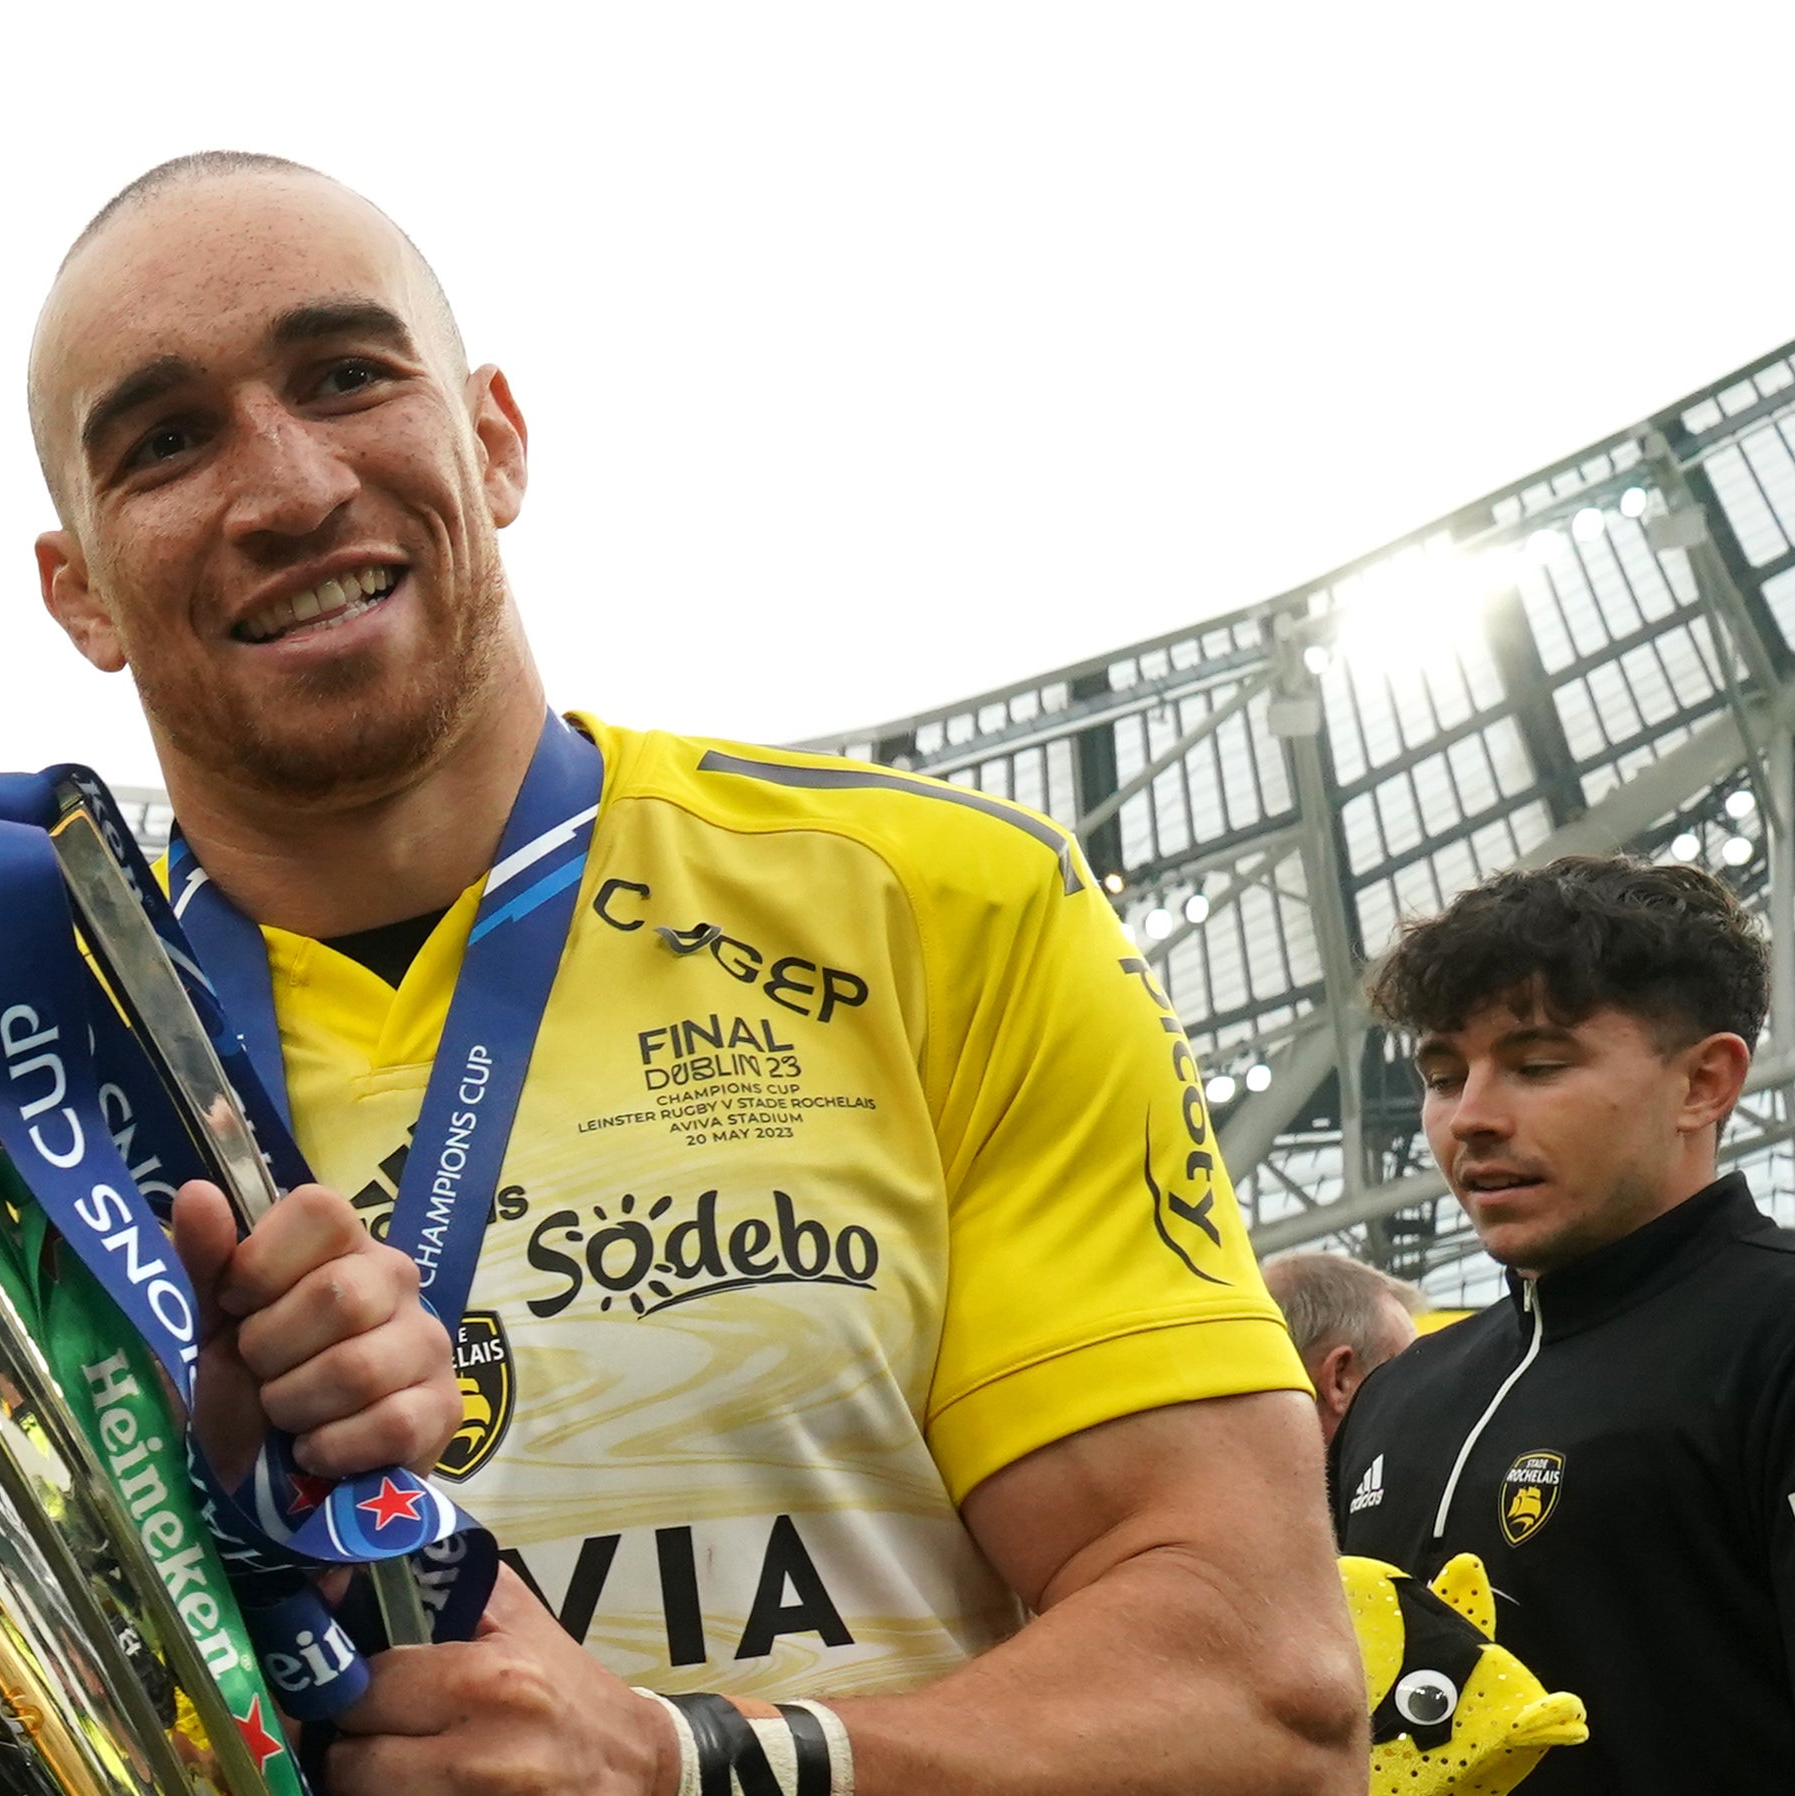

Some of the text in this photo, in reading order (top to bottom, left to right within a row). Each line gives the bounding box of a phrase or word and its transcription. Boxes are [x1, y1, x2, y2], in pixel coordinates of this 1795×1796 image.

[638, 1014, 795, 1065] FINAL
[0, 1003, 86, 1169] CUP
[644, 1053, 802, 1091] DUBLIN 23
[657, 1083, 801, 1106] CHAMPIONS CUP
[578, 1096, 877, 1133] LEINSTER RUGBY V STADE ROCHELAIS
[669, 1112, 804, 1133] AVIVA STADIUM
[687, 1127, 795, 1146] 20 MAY 2023
[414, 1045, 493, 1289] CHAMPIONS CUP
[1506, 1467, 1561, 1485] ROCHELAIS
[81, 1346, 242, 1682] Heineken
